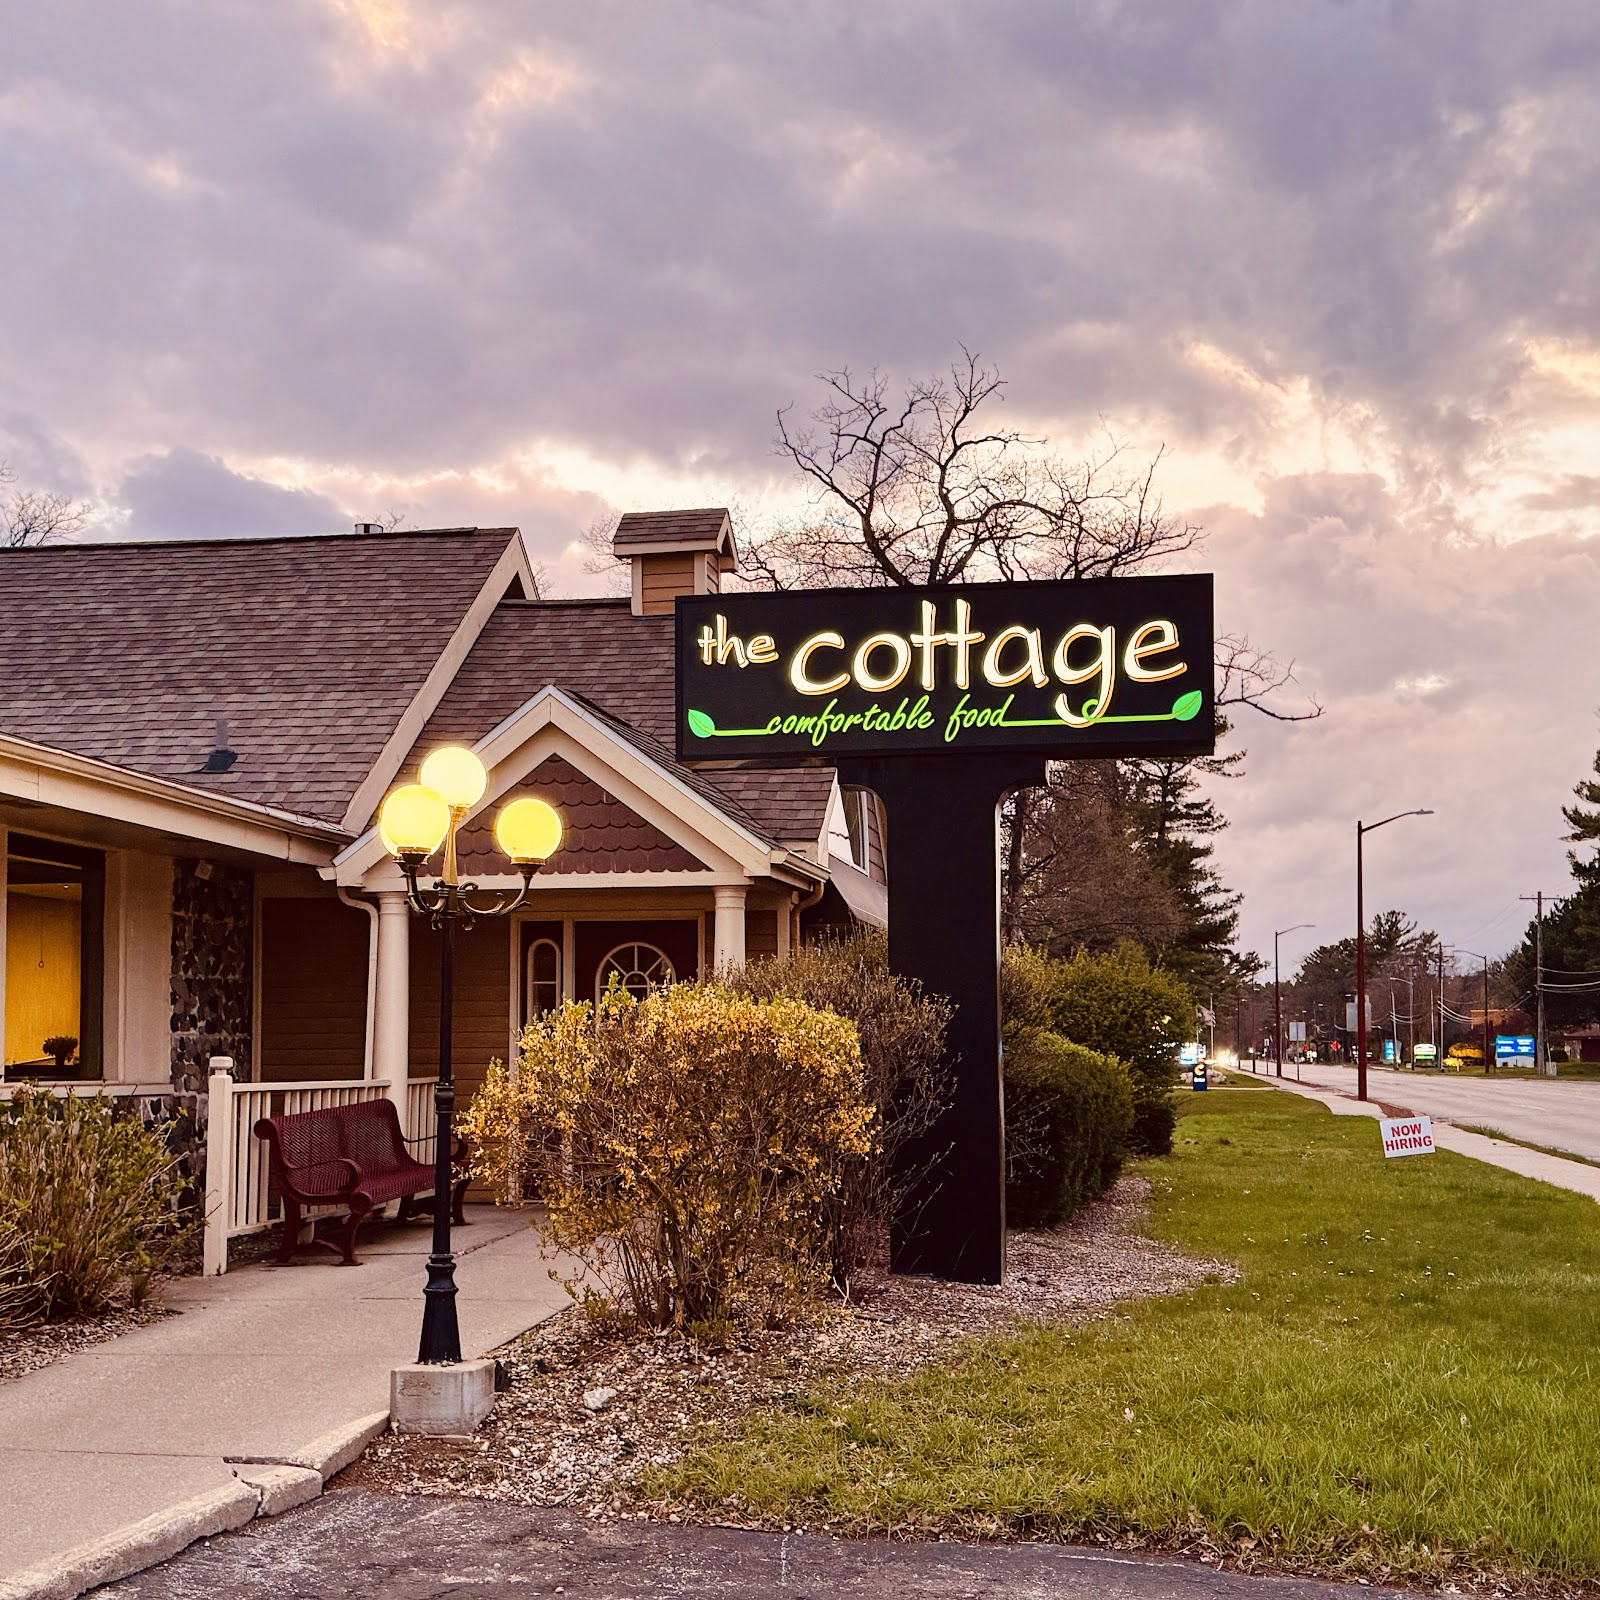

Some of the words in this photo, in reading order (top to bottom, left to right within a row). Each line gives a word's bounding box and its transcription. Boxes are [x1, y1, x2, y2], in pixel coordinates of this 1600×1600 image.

[697, 613, 780, 669] the
[790, 598, 1188, 729] cottage
[766, 694, 936, 747] comfortable
[944, 693, 1015, 743] food
[1385, 1135, 1433, 1151] HIRING
[1391, 1123, 1422, 1138] NOW
